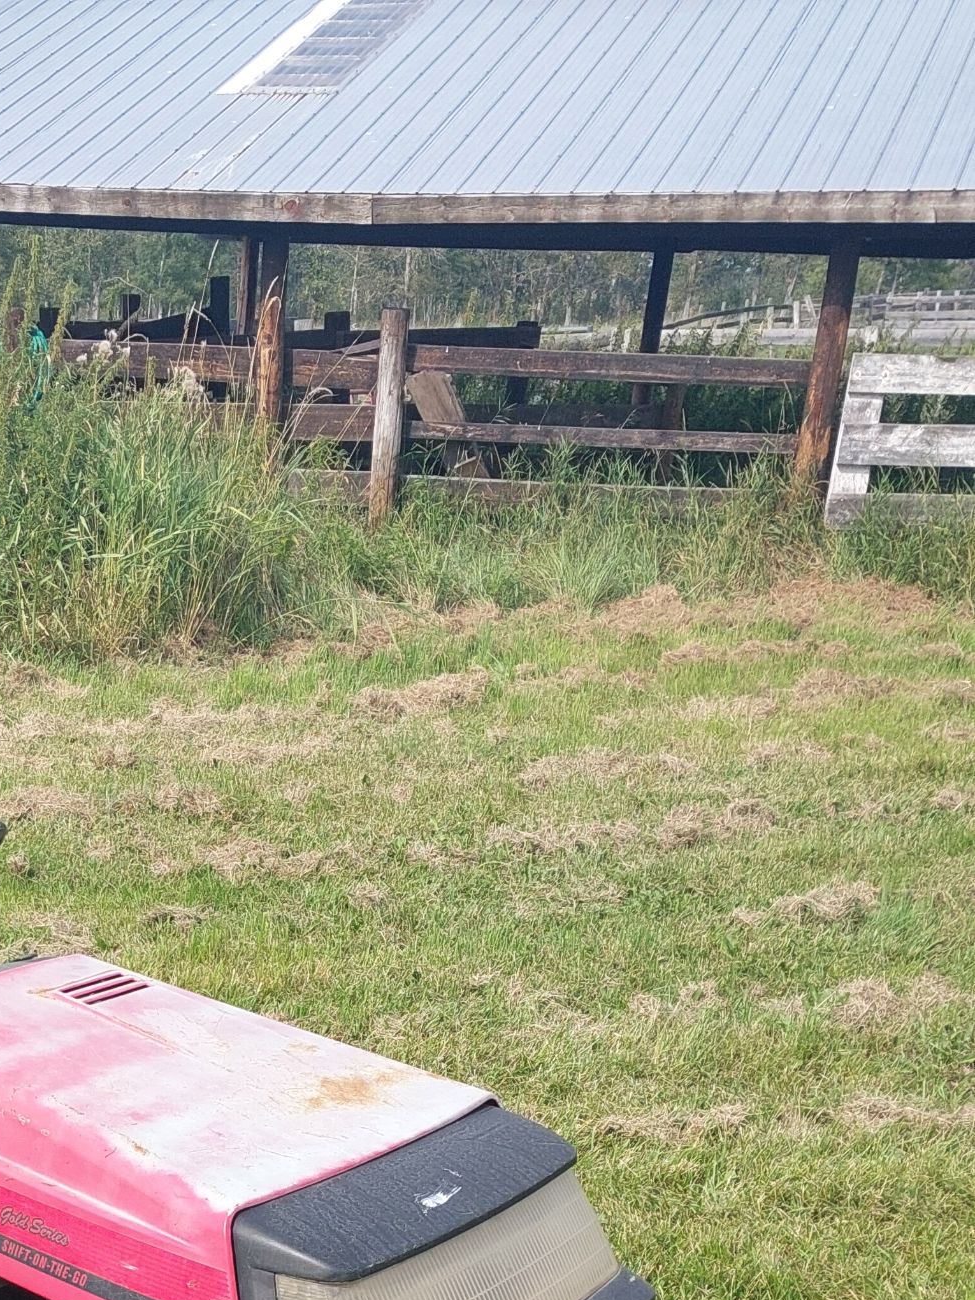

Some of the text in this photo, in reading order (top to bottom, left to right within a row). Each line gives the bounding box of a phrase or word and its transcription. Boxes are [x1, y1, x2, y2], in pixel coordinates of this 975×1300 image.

[0, 1206, 70, 1246] Gold Series
[1, 1239, 88, 1287] SHIFT-ON-THE-GO
